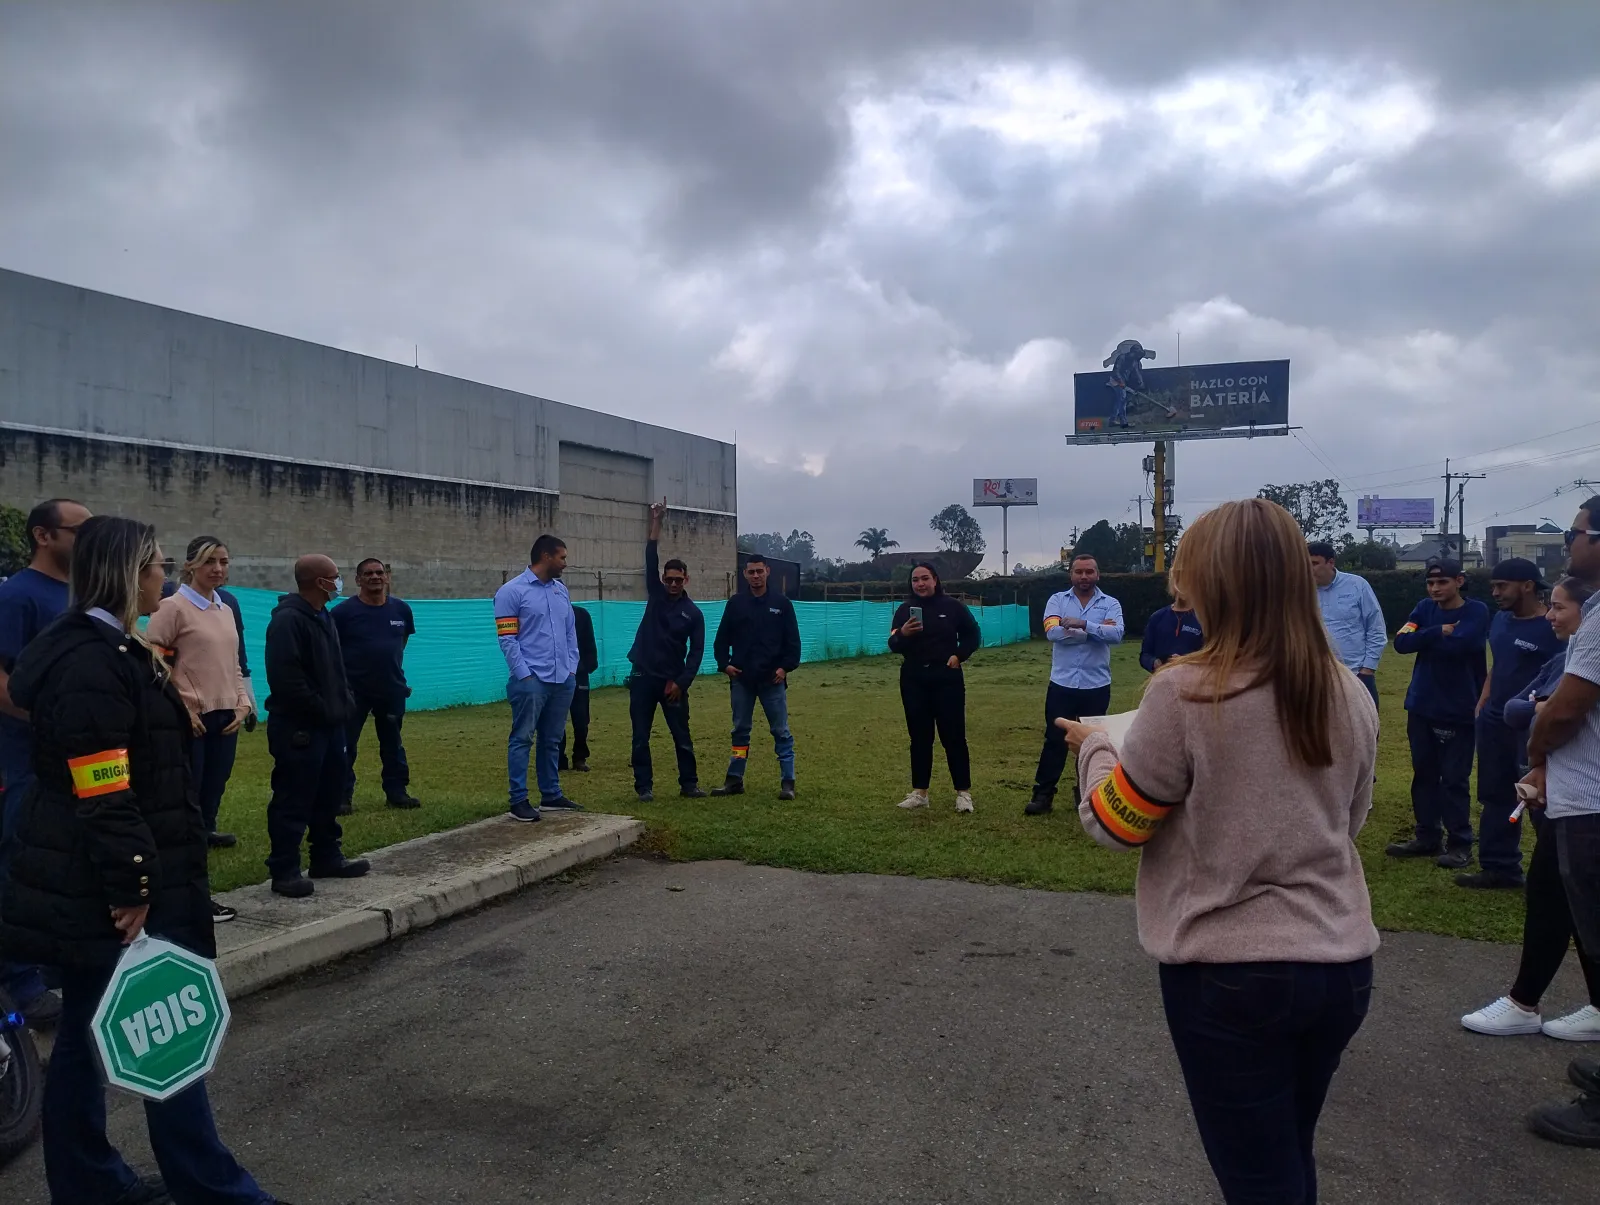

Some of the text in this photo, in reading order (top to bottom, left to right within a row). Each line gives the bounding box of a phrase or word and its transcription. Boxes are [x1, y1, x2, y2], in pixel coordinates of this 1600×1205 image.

[1190, 375, 1268, 389] HAZLO CON
[1190, 387, 1271, 407] BATERÍA
[119, 984, 207, 1058] SIGA
